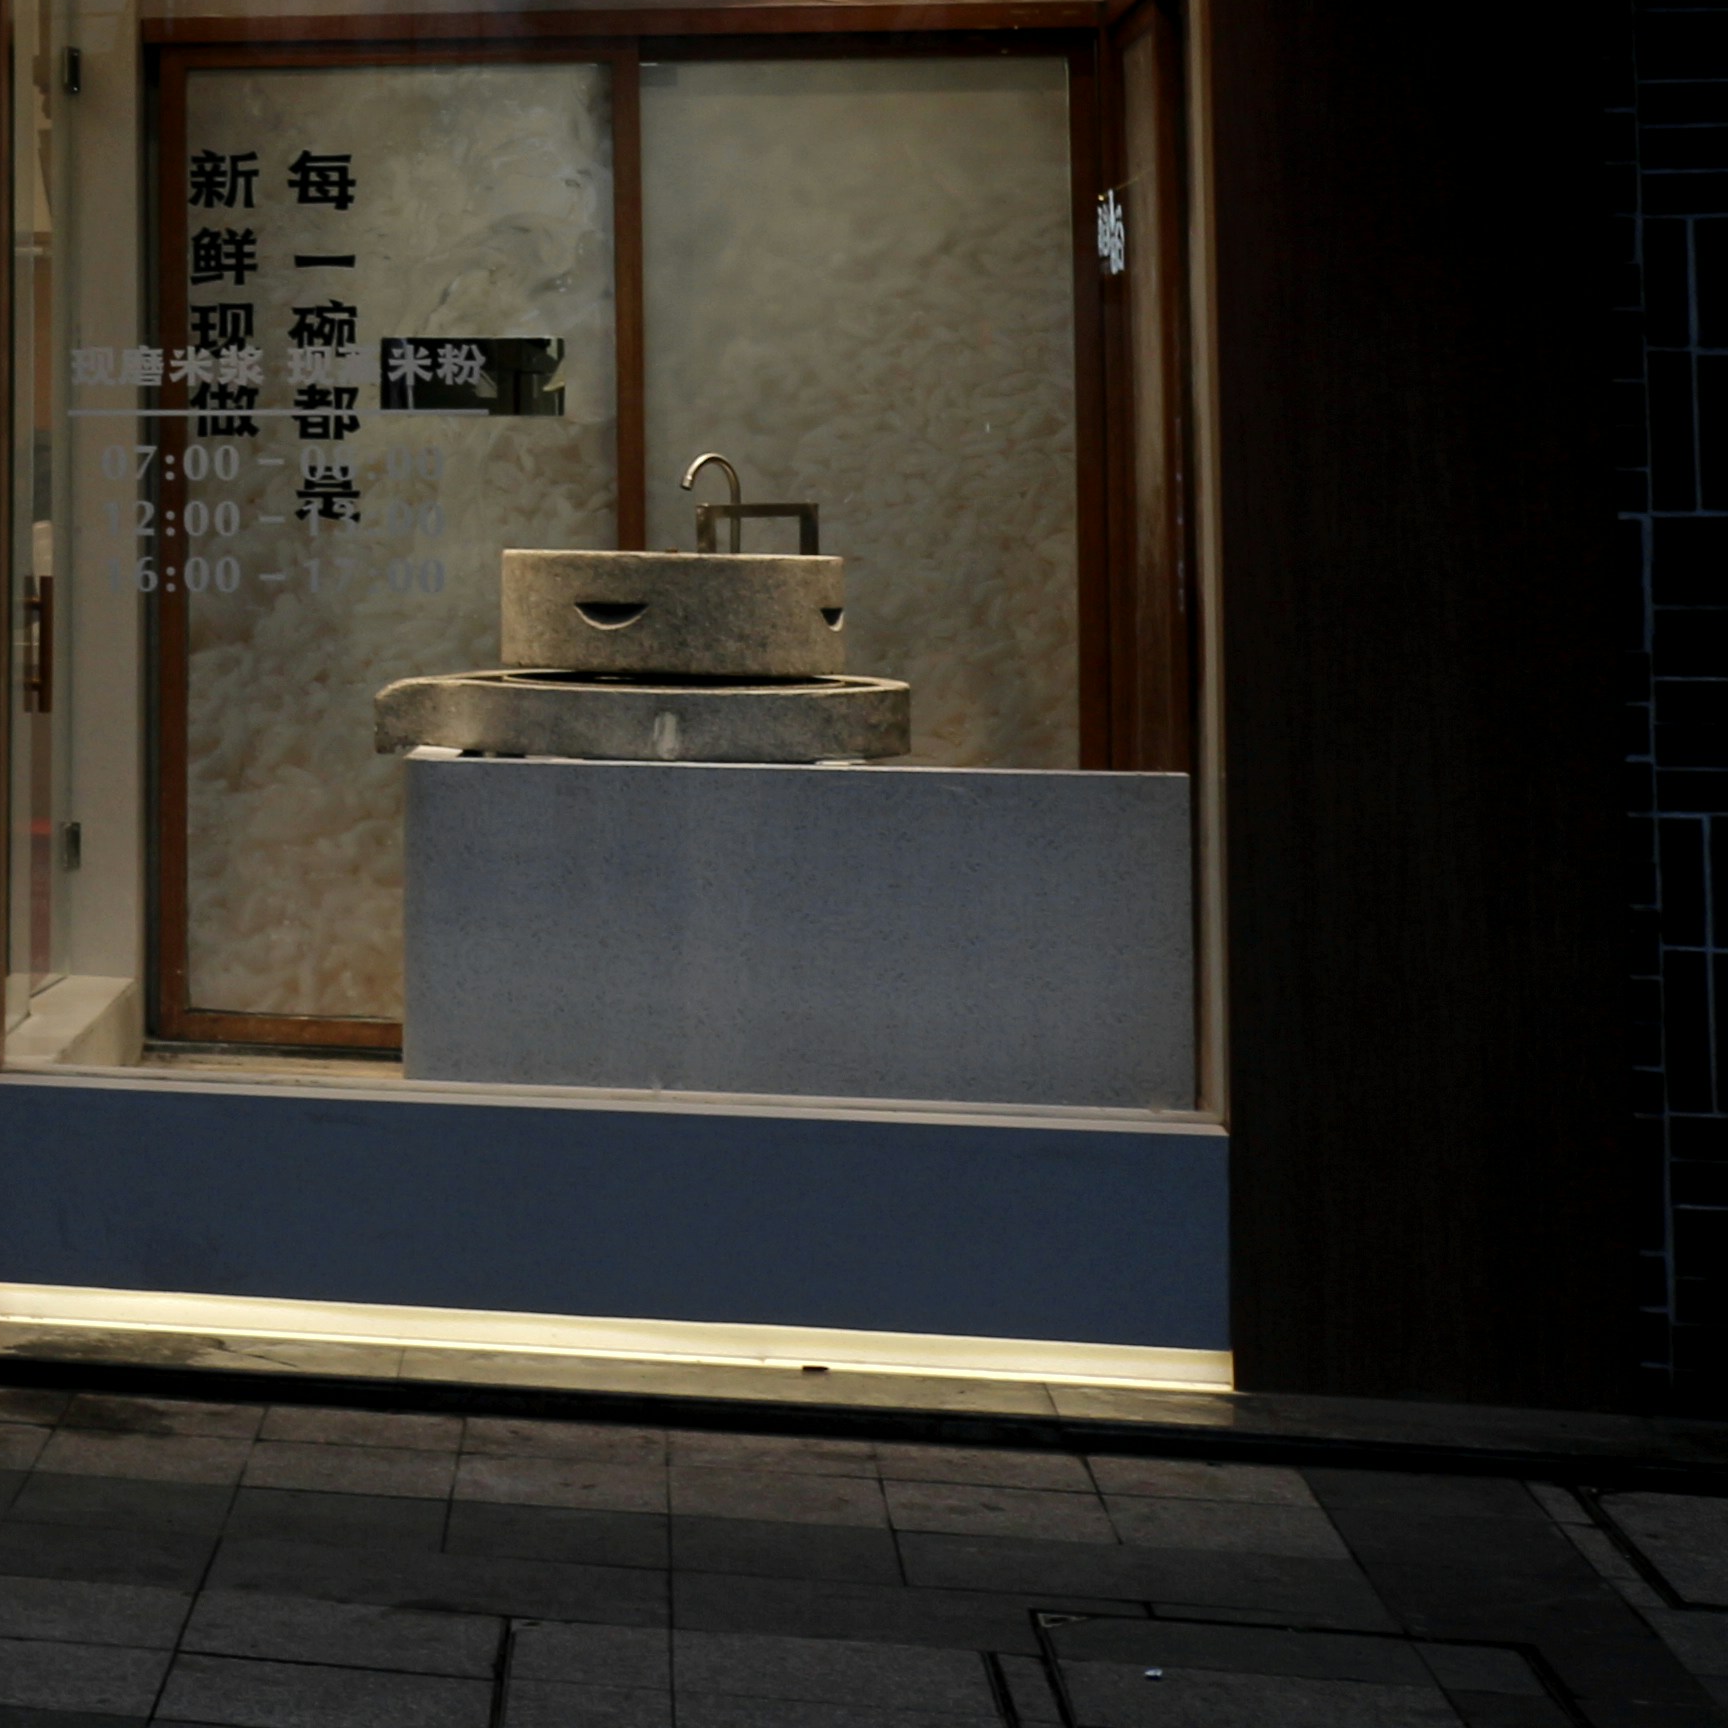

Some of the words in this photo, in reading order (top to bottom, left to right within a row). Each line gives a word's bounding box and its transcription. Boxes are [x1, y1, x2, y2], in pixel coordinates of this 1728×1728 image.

[71, 345, 264, 388] 现磨米浆
[189, 149, 259, 438] 新鲜现做
[287, 150, 360, 523] 每一碗都是
